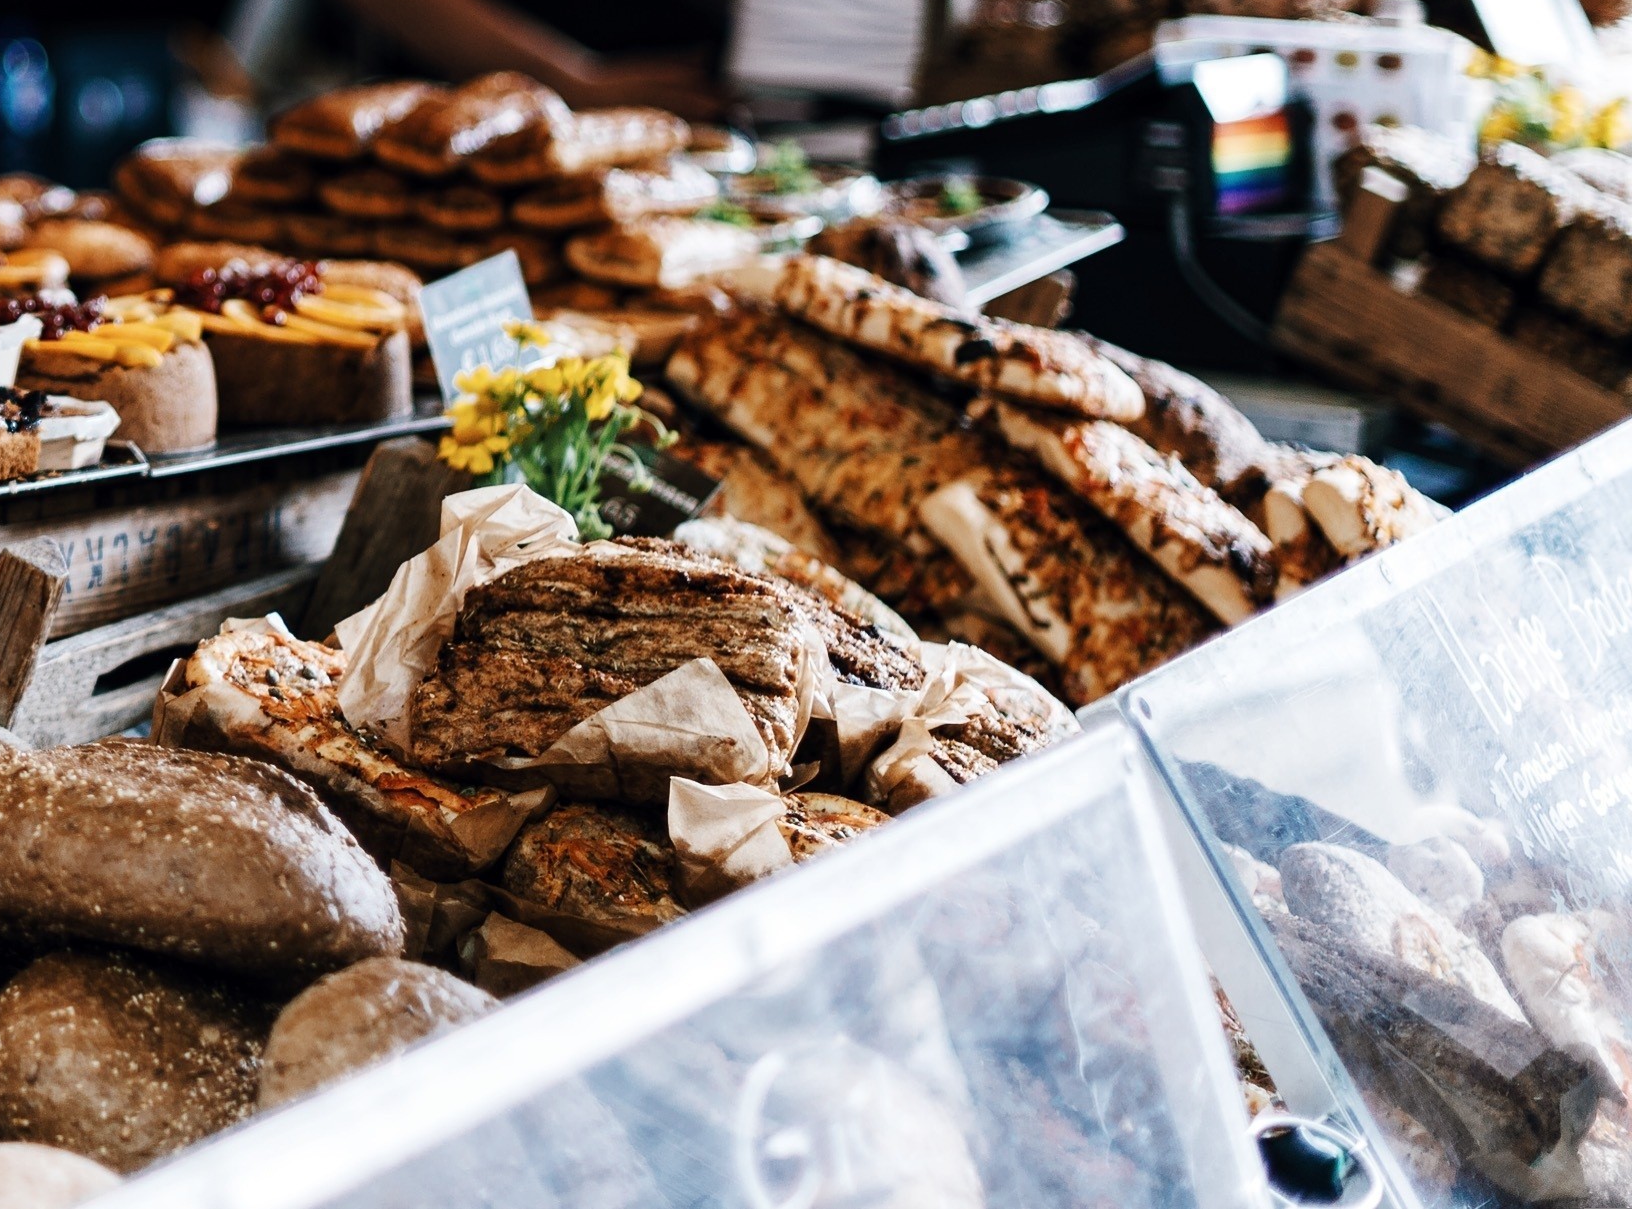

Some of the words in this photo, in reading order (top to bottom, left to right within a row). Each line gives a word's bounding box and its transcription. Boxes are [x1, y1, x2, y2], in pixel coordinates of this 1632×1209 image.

[1417, 585, 1570, 735] Hartige
[1530, 554, 1632, 671] Brode
[1560, 693, 1632, 760] Kappert
